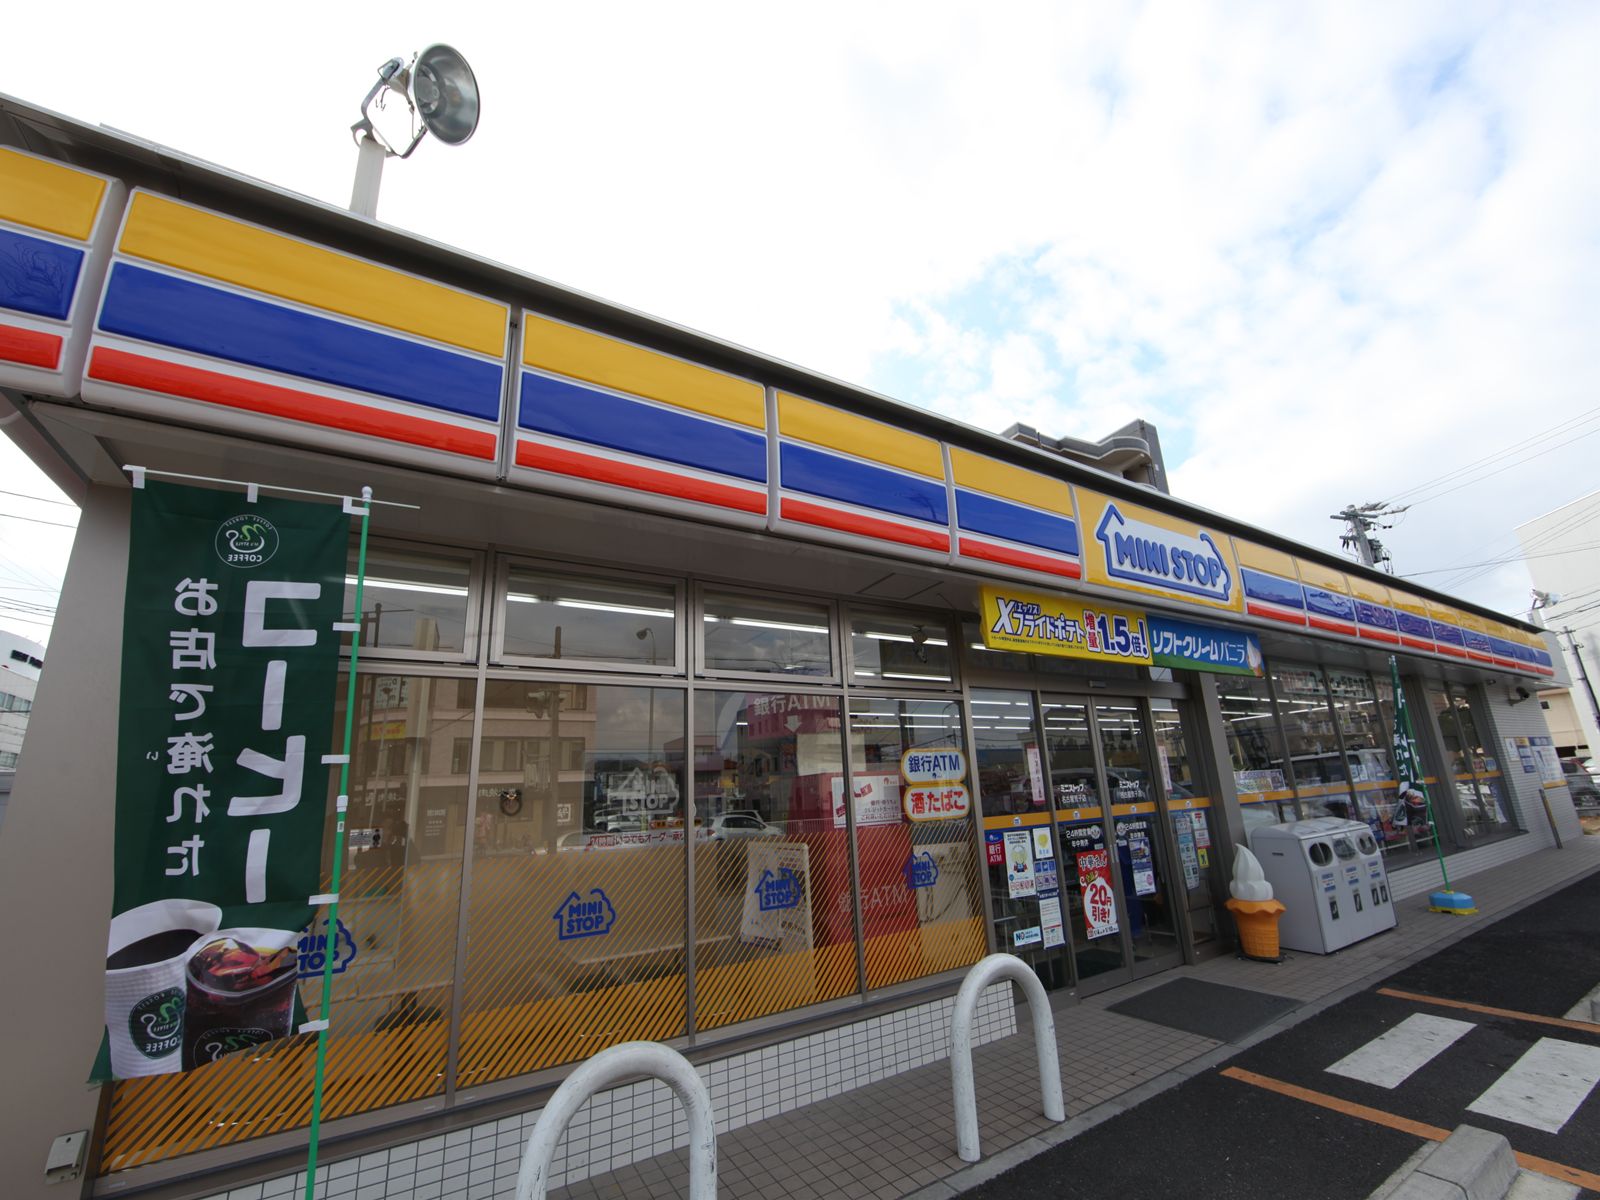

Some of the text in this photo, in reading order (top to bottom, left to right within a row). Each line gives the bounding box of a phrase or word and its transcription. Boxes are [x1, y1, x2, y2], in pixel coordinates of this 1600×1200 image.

[1114, 531, 1221, 587] MINI STOP
[1085, 611, 1099, 649] 増量
[908, 754, 960, 773] 銀行ATM
[629, 793, 668, 811] STOP
[765, 890, 793, 906] STOP
[568, 900, 602, 918] MINI
[566, 915, 604, 934] STOP
